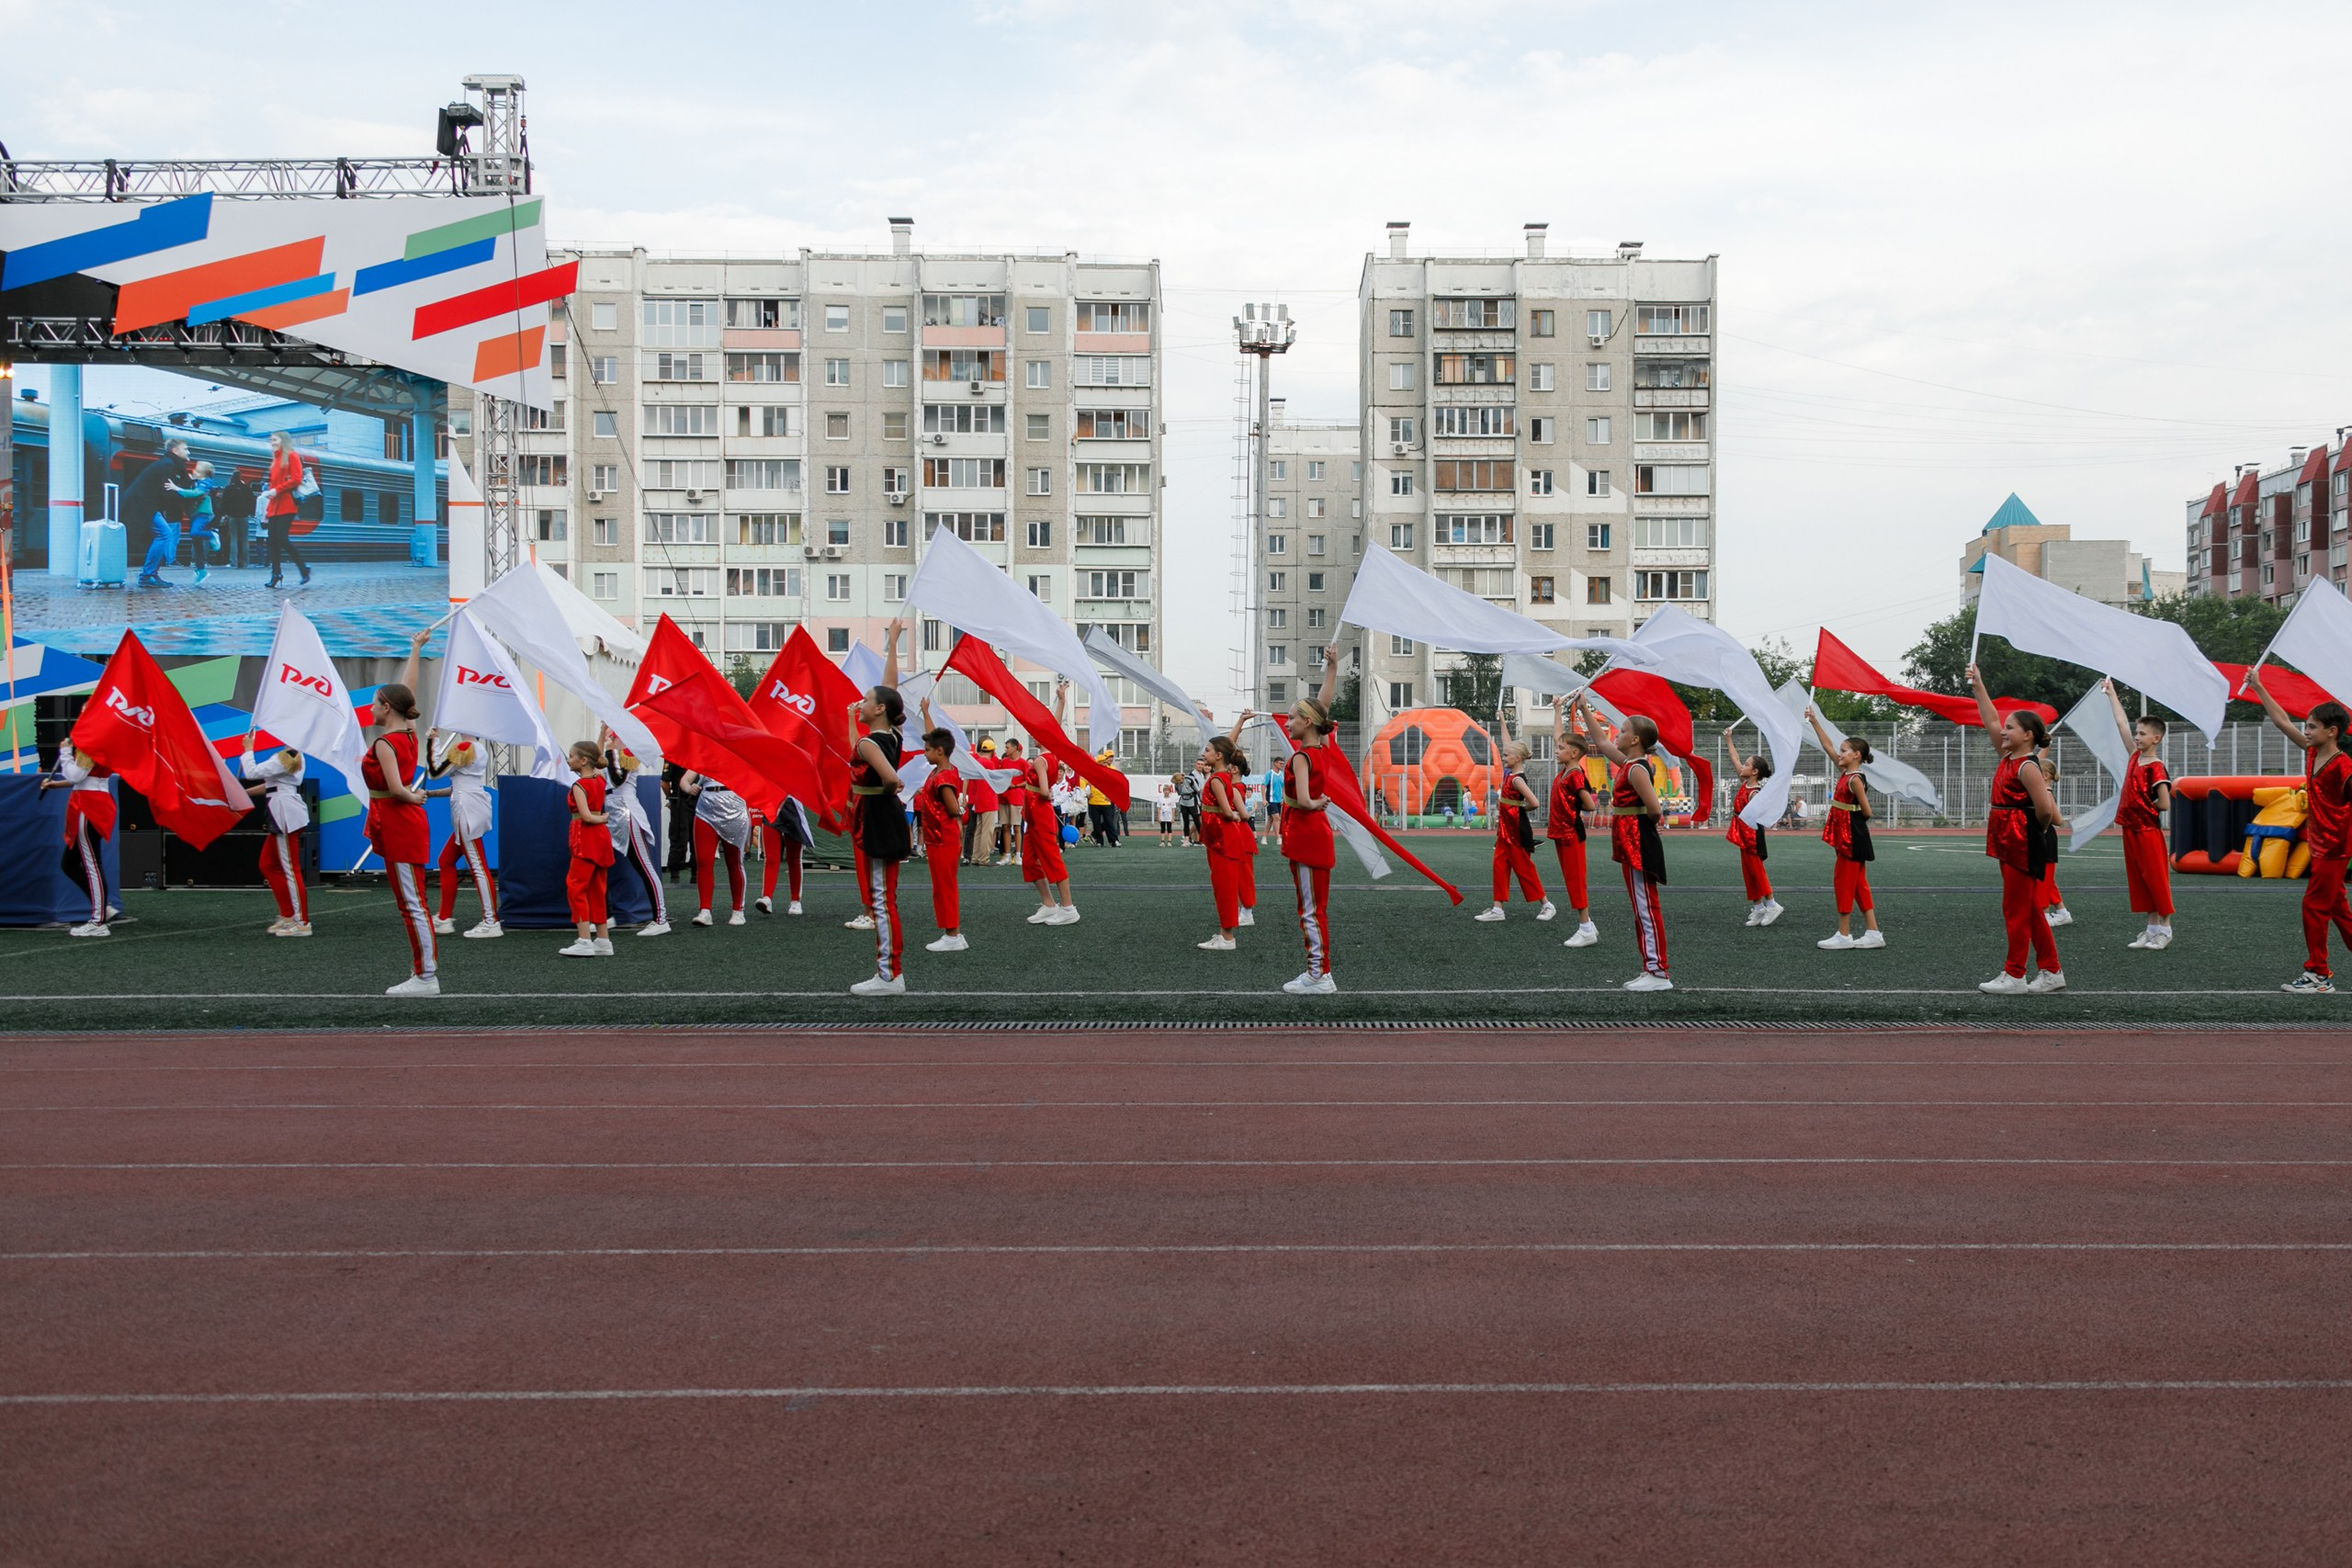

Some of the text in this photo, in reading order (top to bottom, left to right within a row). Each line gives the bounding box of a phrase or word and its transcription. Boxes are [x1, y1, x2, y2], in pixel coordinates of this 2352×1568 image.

[280, 662, 333, 697] РЖД
[770, 679, 816, 716] РЖД
[105, 685, 155, 728] РЖД
